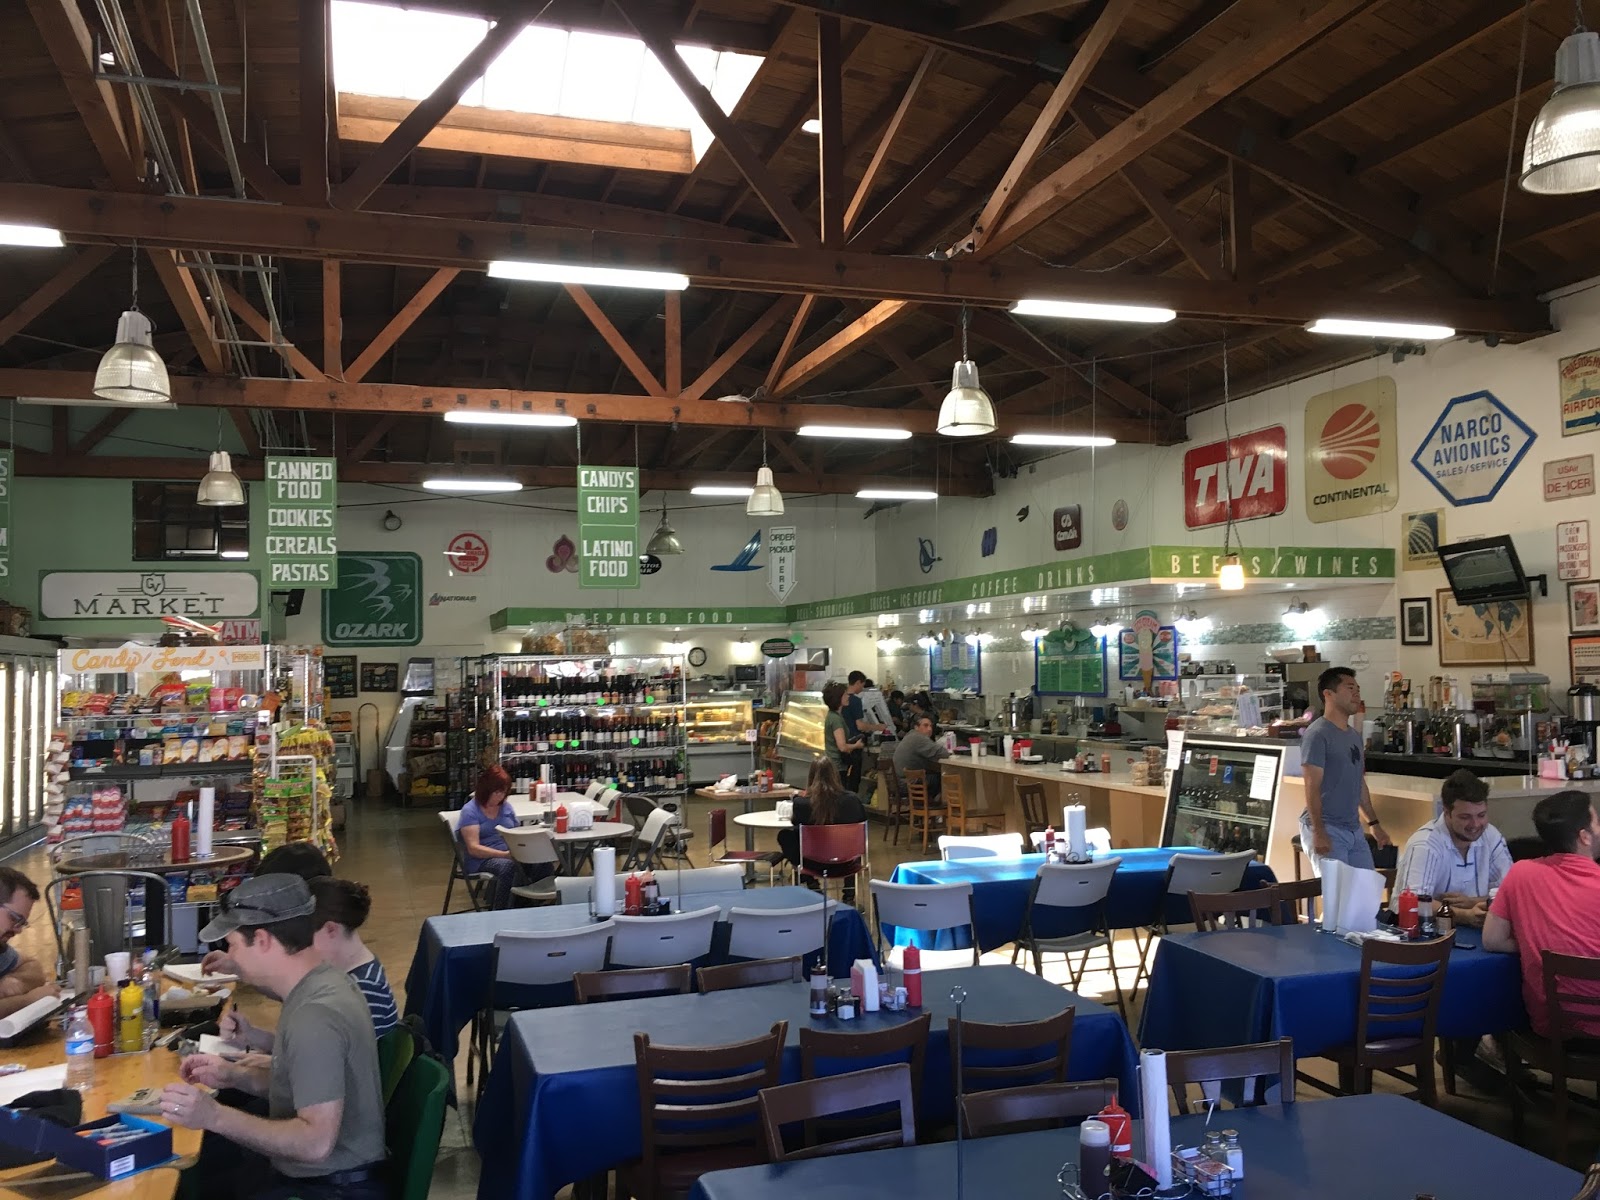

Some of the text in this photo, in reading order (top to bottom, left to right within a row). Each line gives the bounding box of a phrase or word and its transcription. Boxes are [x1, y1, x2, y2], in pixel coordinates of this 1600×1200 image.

[1563, 396, 1600, 415] AIRPOR
[1441, 413, 1502, 444] NARCO
[1433, 434, 1510, 467] AVIONICS
[267, 461, 333, 480] CANNED
[580, 470, 635, 488] CANDYS
[1194, 452, 1275, 507] TWA
[277, 481, 322, 499] FOOD
[1313, 482, 1390, 506] CONTINENTAL
[1547, 478, 1591, 493] DE-ICER
[587, 496, 628, 513] CHIPS
[268, 508, 333, 527] COOKIES
[266, 536, 337, 554] CEREALS
[769, 533, 795, 541] ORDER
[583, 540, 634, 557] LATINO
[272, 564, 330, 581] PASTAS
[589, 560, 628, 577] FOOD
[972, 564, 1094, 599] COFFEE DRINKS
[74, 598, 225, 615] MARKET
[687, 612, 733, 624] FOOD
[222, 621, 260, 639] ATM
[335, 622, 409, 638] OZARK
[72, 649, 146, 672] Candy
